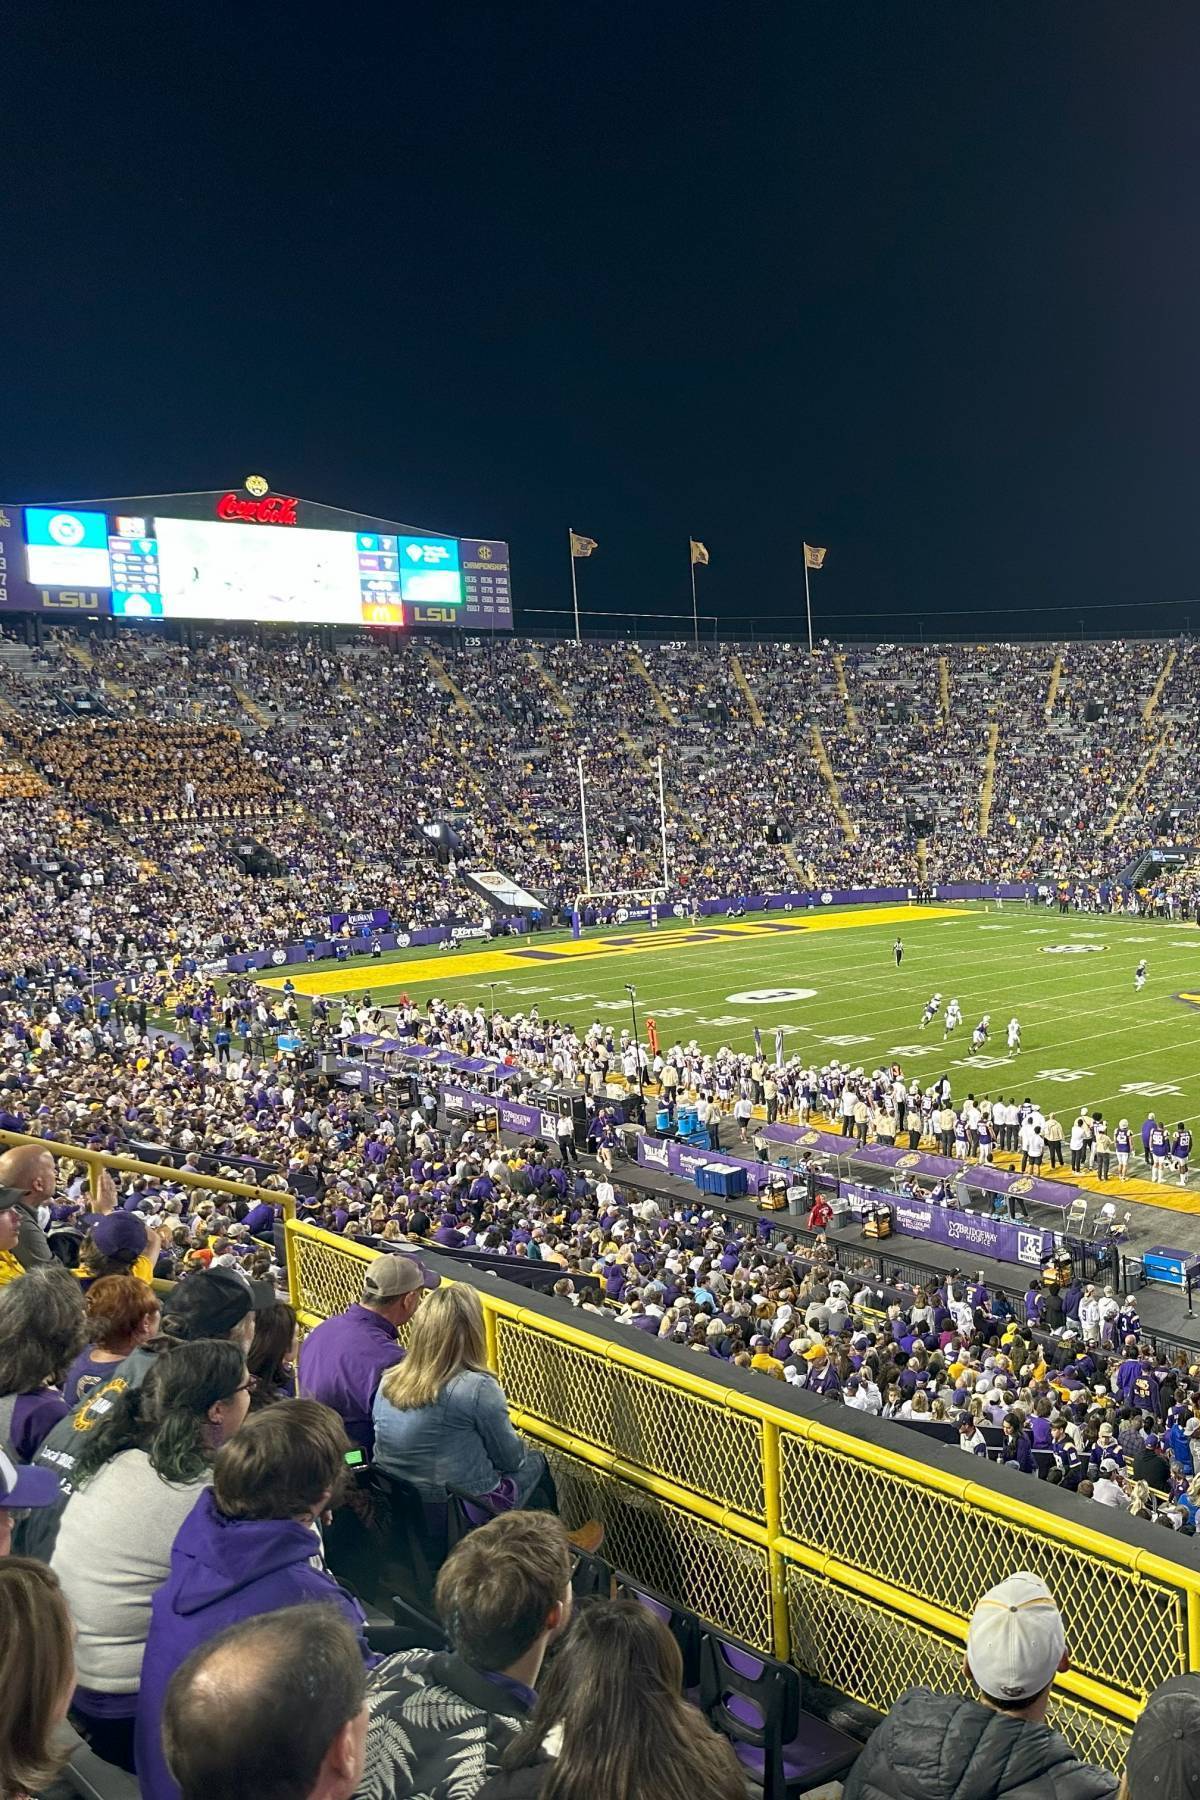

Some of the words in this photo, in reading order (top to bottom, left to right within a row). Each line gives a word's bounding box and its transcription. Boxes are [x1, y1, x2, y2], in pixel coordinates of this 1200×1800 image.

[217, 491, 298, 525] Coca-Cola
[463, 561, 508, 572] CHAMPIONSHIPS
[42, 590, 98, 608] LSU
[414, 606, 456, 623] LSU
[464, 638, 481, 647] 235
[669, 641, 687, 651] 237
[950, 1055, 1016, 1069] 50
[1034, 1068, 1096, 1082] 45
[1118, 1081, 1183, 1097] 40
[959, 1224, 998, 1242] BRIDGEWAY
[966, 1234, 991, 1247] HOSPICE
[967, 1291, 973, 1303] 2
[1121, 1317, 1128, 1332] 3
